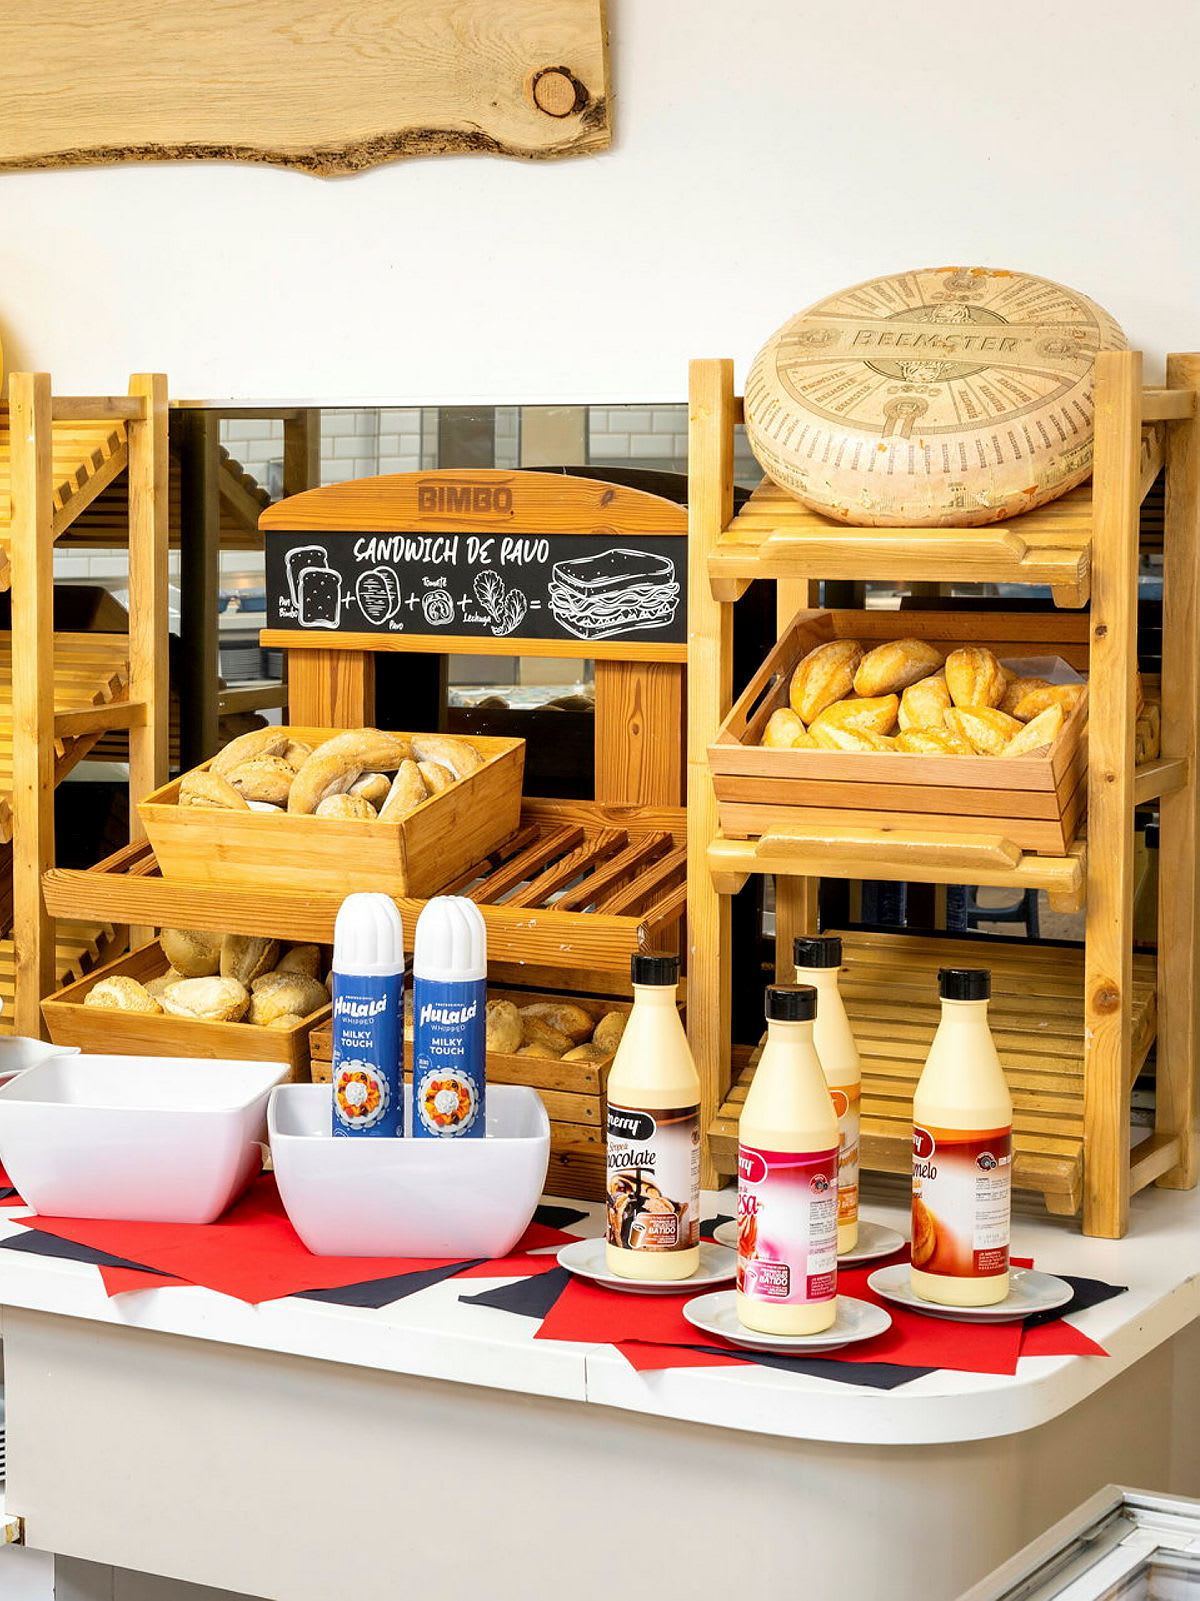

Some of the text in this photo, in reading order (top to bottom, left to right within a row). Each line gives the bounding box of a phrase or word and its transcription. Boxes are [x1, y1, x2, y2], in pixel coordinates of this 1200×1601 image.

[852, 329, 1018, 352] BEEMSTER
[418, 486, 513, 515] BIMBO
[353, 535, 550, 566] SANDWICH DE PAVO
[431, 1024, 466, 1033] WHIPPED
[342, 1029, 372, 1039] MILKY
[340, 1038, 373, 1048] TOUCH
[431, 1037, 463, 1047] MILKY
[429, 1046, 465, 1055] TOUCH
